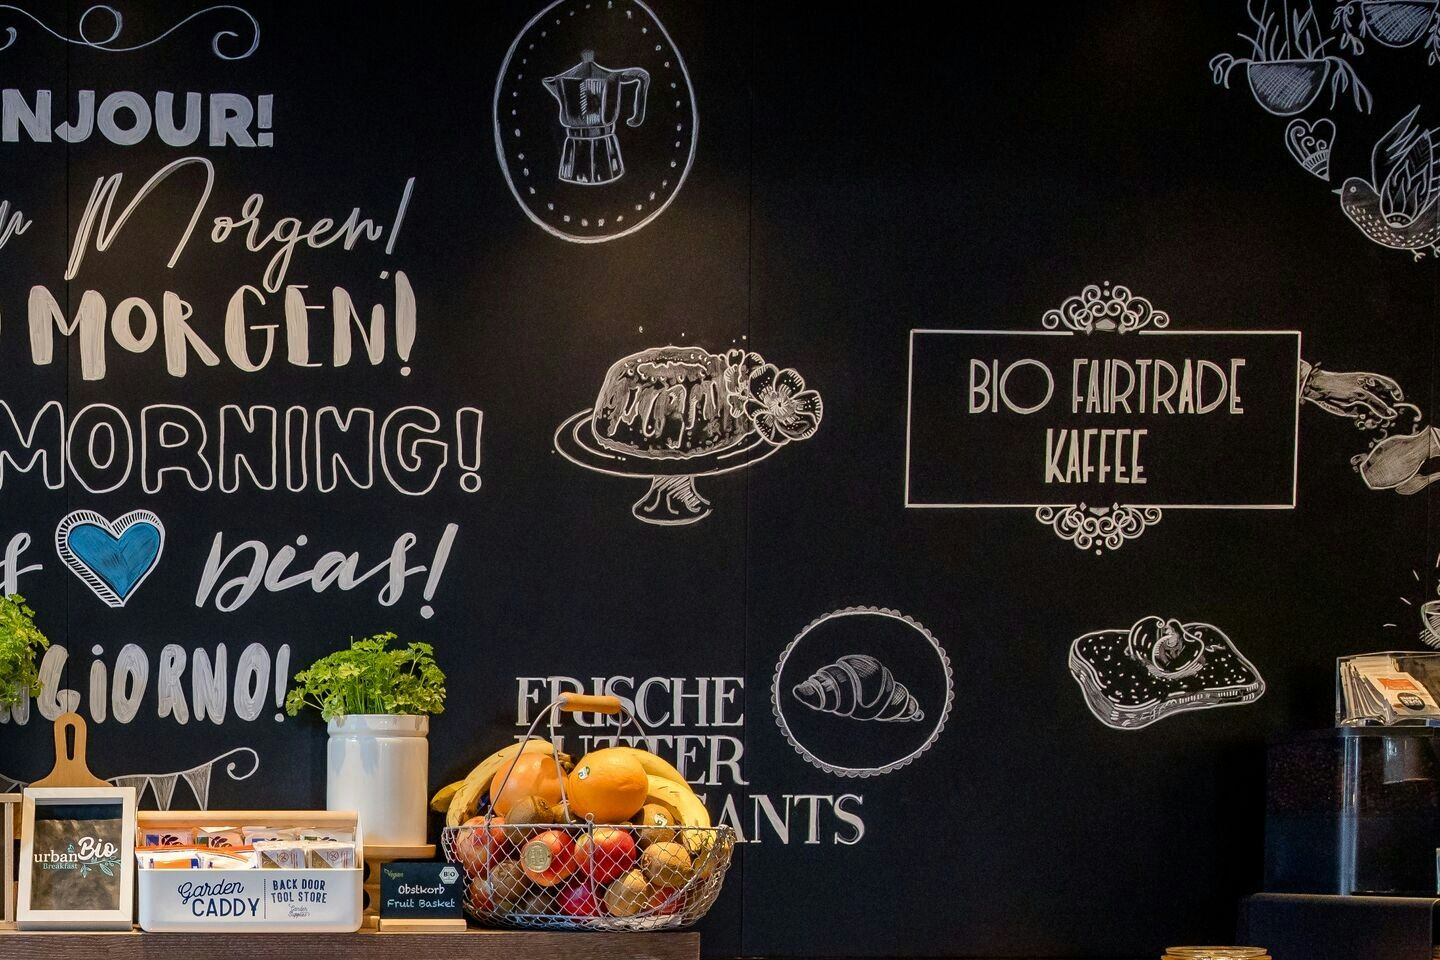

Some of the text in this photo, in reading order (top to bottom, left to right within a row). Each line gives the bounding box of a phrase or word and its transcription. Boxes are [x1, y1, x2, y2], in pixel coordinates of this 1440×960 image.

[64, 156, 415, 293] Morgen!
[29, 269, 417, 381] MORGEN!
[969, 358, 1246, 415] BIO FAIRTRADE
[1045, 428, 1148, 484] KAFFEE
[195, 523, 459, 619] Dias!
[515, 675, 744, 728] FRISCHE
[33, 836, 118, 863] urban Bio
[177, 878, 244, 904] Garden
[271, 892, 328, 904] TOOL STORE
[273, 879, 326, 891] BACK DOOR
[398, 884, 445, 895] Obstkorb
[192, 898, 260, 917] CADDY
[387, 898, 455, 908] Fruit Basket
